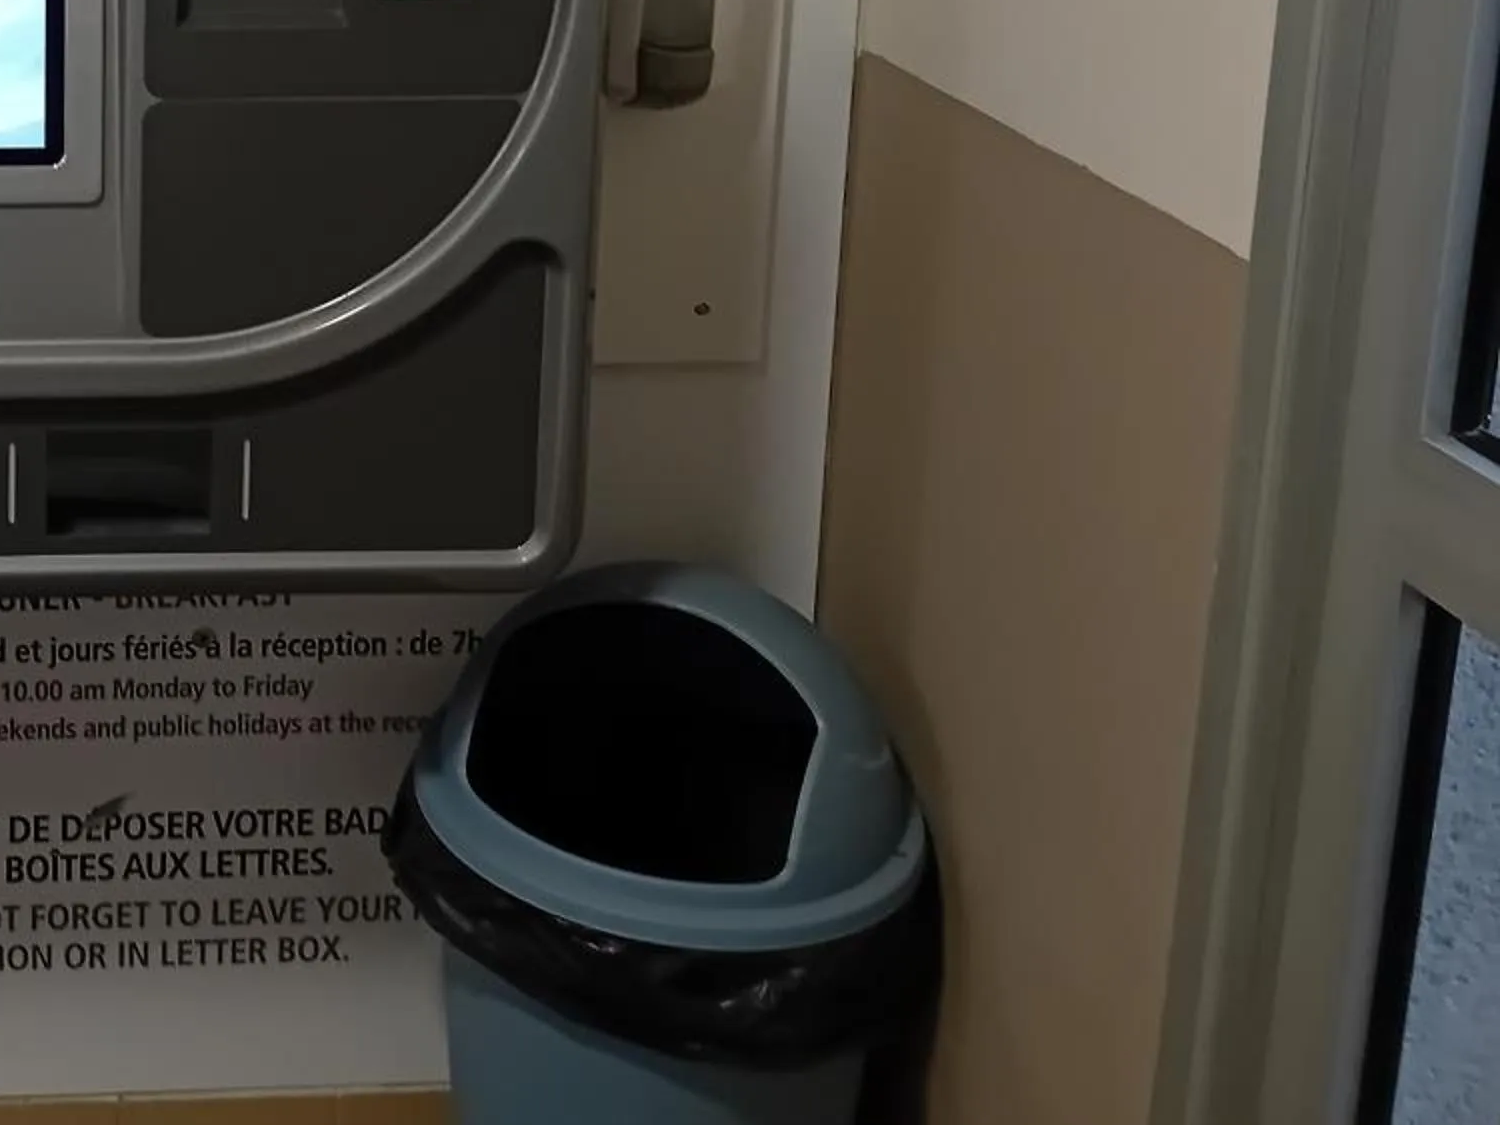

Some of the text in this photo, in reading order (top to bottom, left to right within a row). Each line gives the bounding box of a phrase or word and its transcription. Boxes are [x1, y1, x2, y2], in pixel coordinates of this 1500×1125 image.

[15, 638, 42, 663] et
[49, 634, 115, 669] jours
[122, 632, 197, 661] fériés
[230, 630, 253, 658] la
[260, 629, 387, 665] réception
[410, 629, 442, 656] de
[2, 681, 63, 704] 10.00
[69, 683, 106, 701] am
[112, 675, 204, 706] Monday
[213, 678, 236, 698] to
[243, 673, 313, 704] Friday
[83, 714, 126, 739] and
[133, 711, 202, 743] public
[209, 709, 302, 738] holidays
[309, 712, 333, 734] at
[339, 708, 376, 733] the
[8, 813, 51, 844] DE
[212, 807, 315, 840] VOTRE
[5, 849, 115, 884] BOÎTES
[122, 850, 190, 881] AUX
[200, 847, 334, 879] LETTRES.
[30, 900, 151, 932] FORGET
[159, 899, 200, 929] TO
[211, 896, 307, 926] LEAVE
[316, 894, 404, 924] YOUR
[64, 942, 107, 971] OR
[118, 941, 151, 969] IN
[160, 938, 269, 968] LETTER
[277, 935, 350, 964] BOX.
